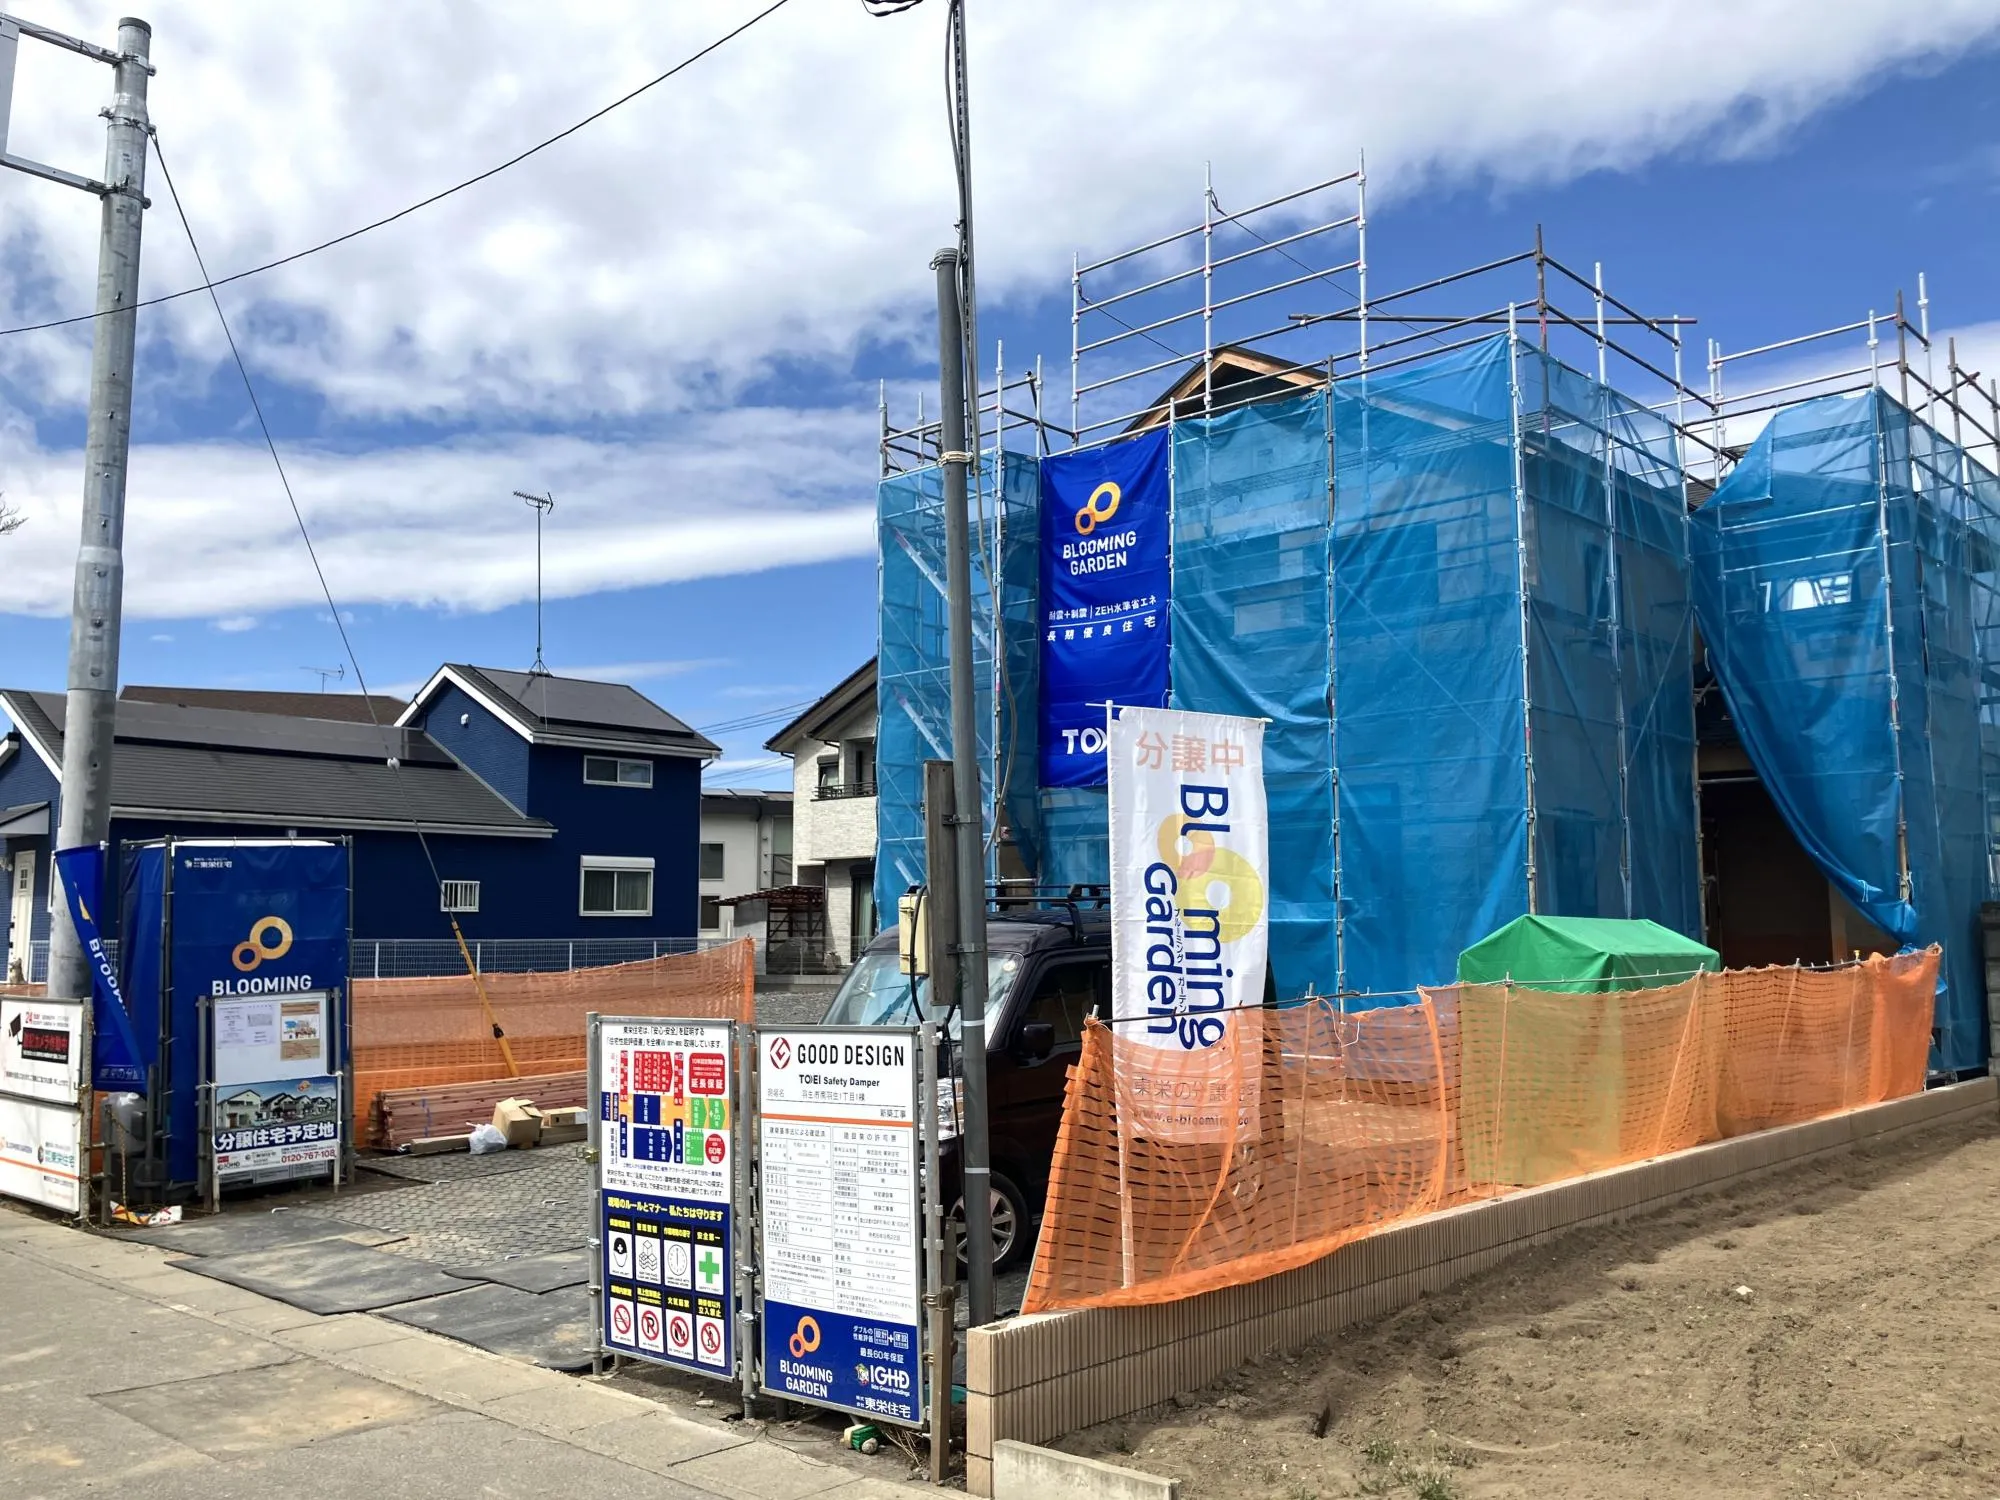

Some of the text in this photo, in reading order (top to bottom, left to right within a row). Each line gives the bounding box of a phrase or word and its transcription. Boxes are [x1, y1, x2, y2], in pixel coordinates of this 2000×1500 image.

[1063, 530, 1137, 560] BLOOMING
[1070, 551, 1127, 576] GARDEN
[1135, 731, 1245, 775] 分譲中
[1144, 862, 1183, 1035] Garden
[212, 974, 312, 996] BLOOMING
[798, 1043, 904, 1066] GOOD DESIGN
[799, 1074, 880, 1088] TOEI Safety Damper
[880, 1108, 907, 1119] 新築工事
[218, 1121, 335, 1151] 分譲住宅予定地
[669, 1204, 724, 1222] 私たちは守ります
[697, 1231, 721, 1242] 安全第一
[860, 1348, 904, 1364] 最長60年保証
[780, 1359, 833, 1383] BLOOMING
[870, 1364, 910, 1389] IGHD
[786, 1376, 828, 1398] GARDEN
[865, 1397, 911, 1418] 東栄住宅
